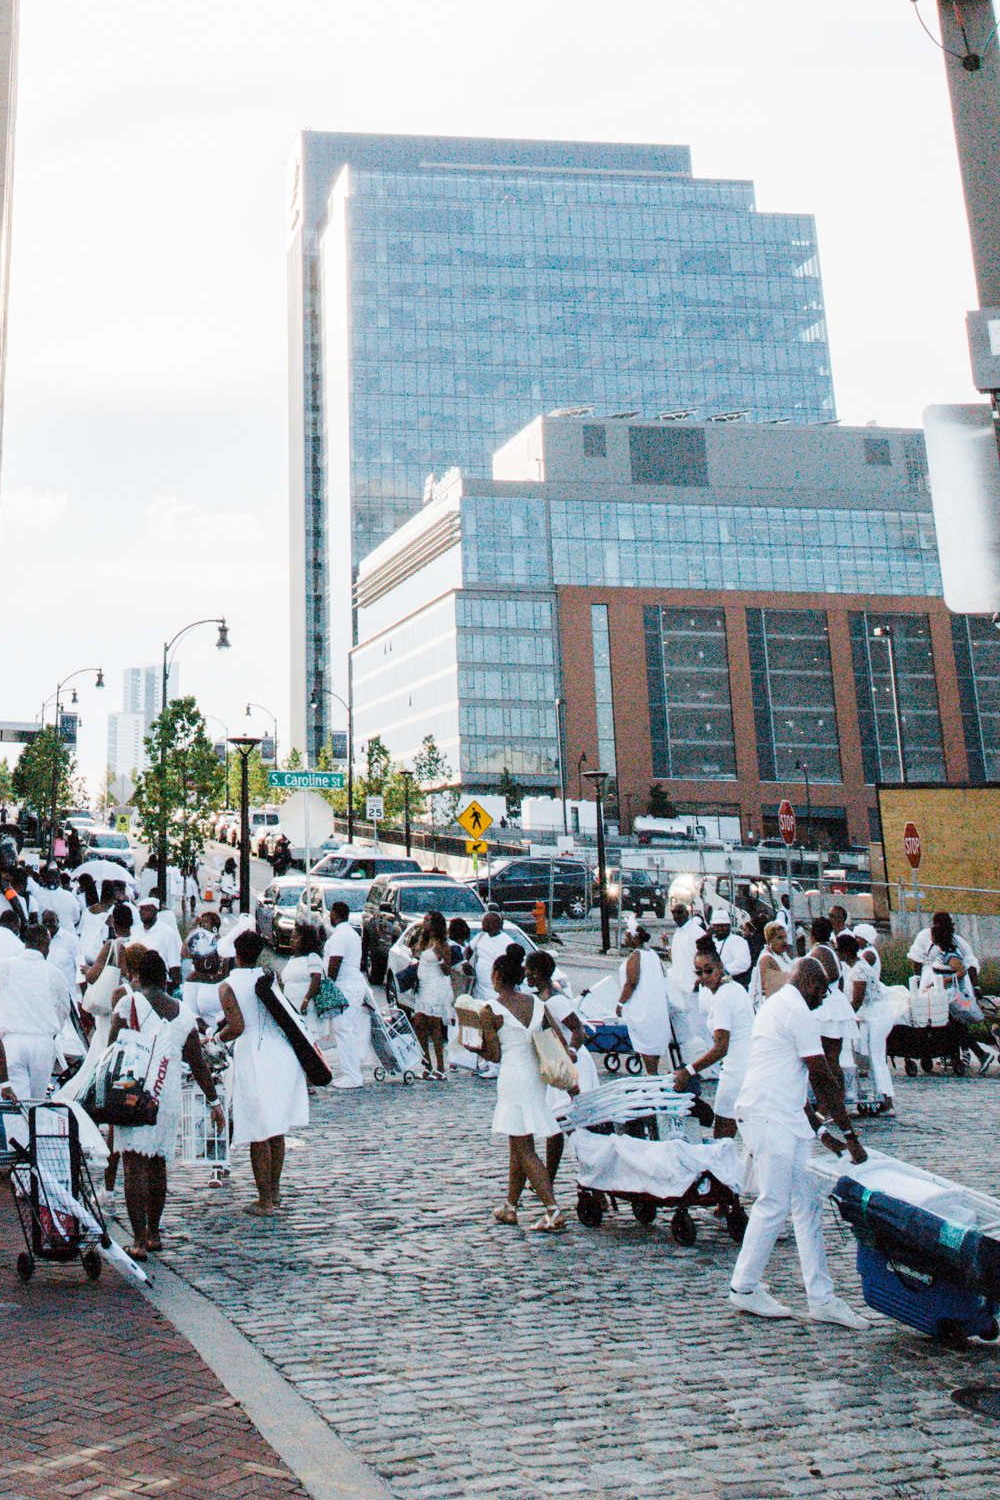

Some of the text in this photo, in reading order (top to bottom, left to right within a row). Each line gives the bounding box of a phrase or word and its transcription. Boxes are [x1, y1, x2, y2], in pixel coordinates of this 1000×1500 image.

[271, 773, 280, 785] S.
[284, 774, 329, 787] Caroline
[368, 808, 382, 817] 25
[780, 814, 795, 831] STOP
[905, 837, 920, 854] STOP
